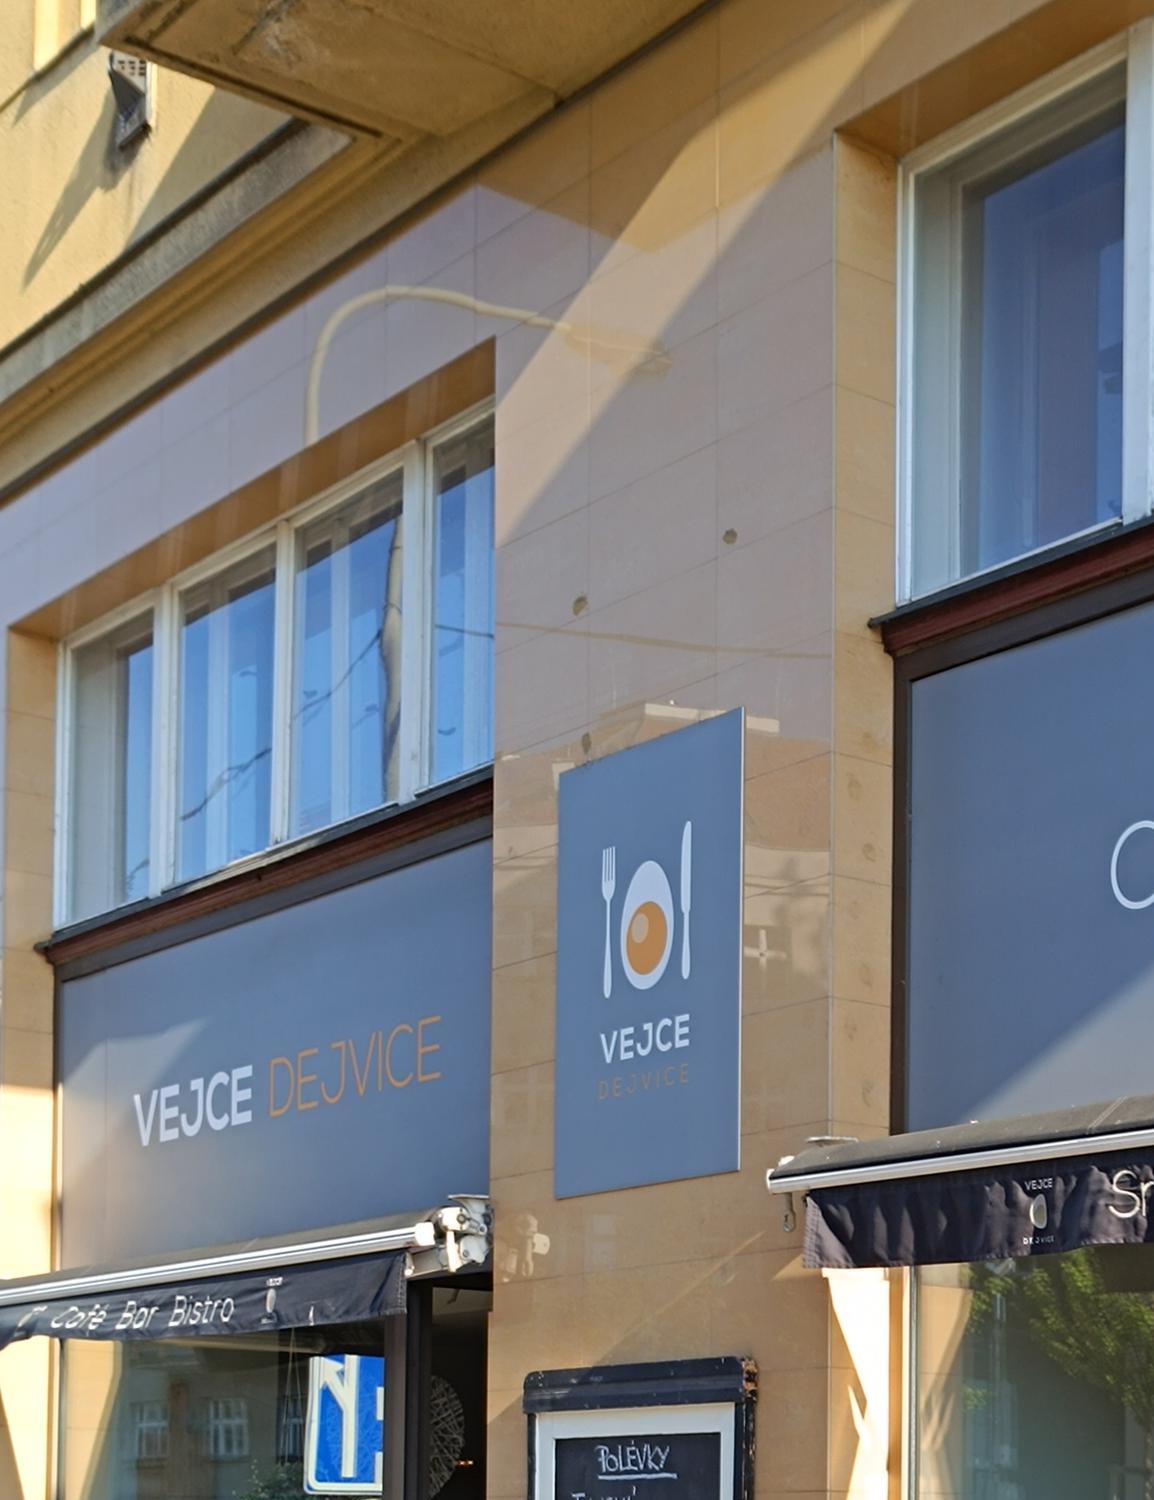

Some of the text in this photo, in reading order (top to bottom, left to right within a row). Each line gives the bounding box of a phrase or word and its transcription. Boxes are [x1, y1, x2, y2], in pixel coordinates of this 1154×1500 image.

[600, 1013, 691, 1064] VEJCE
[133, 1015, 442, 1147] VEJCE DEJVICE
[597, 1063, 689, 1100] DEJVICE
[1025, 1178, 1053, 1190] VEJCE
[115, 1300, 159, 1331] Bar
[168, 1295, 235, 1327] Bistro
